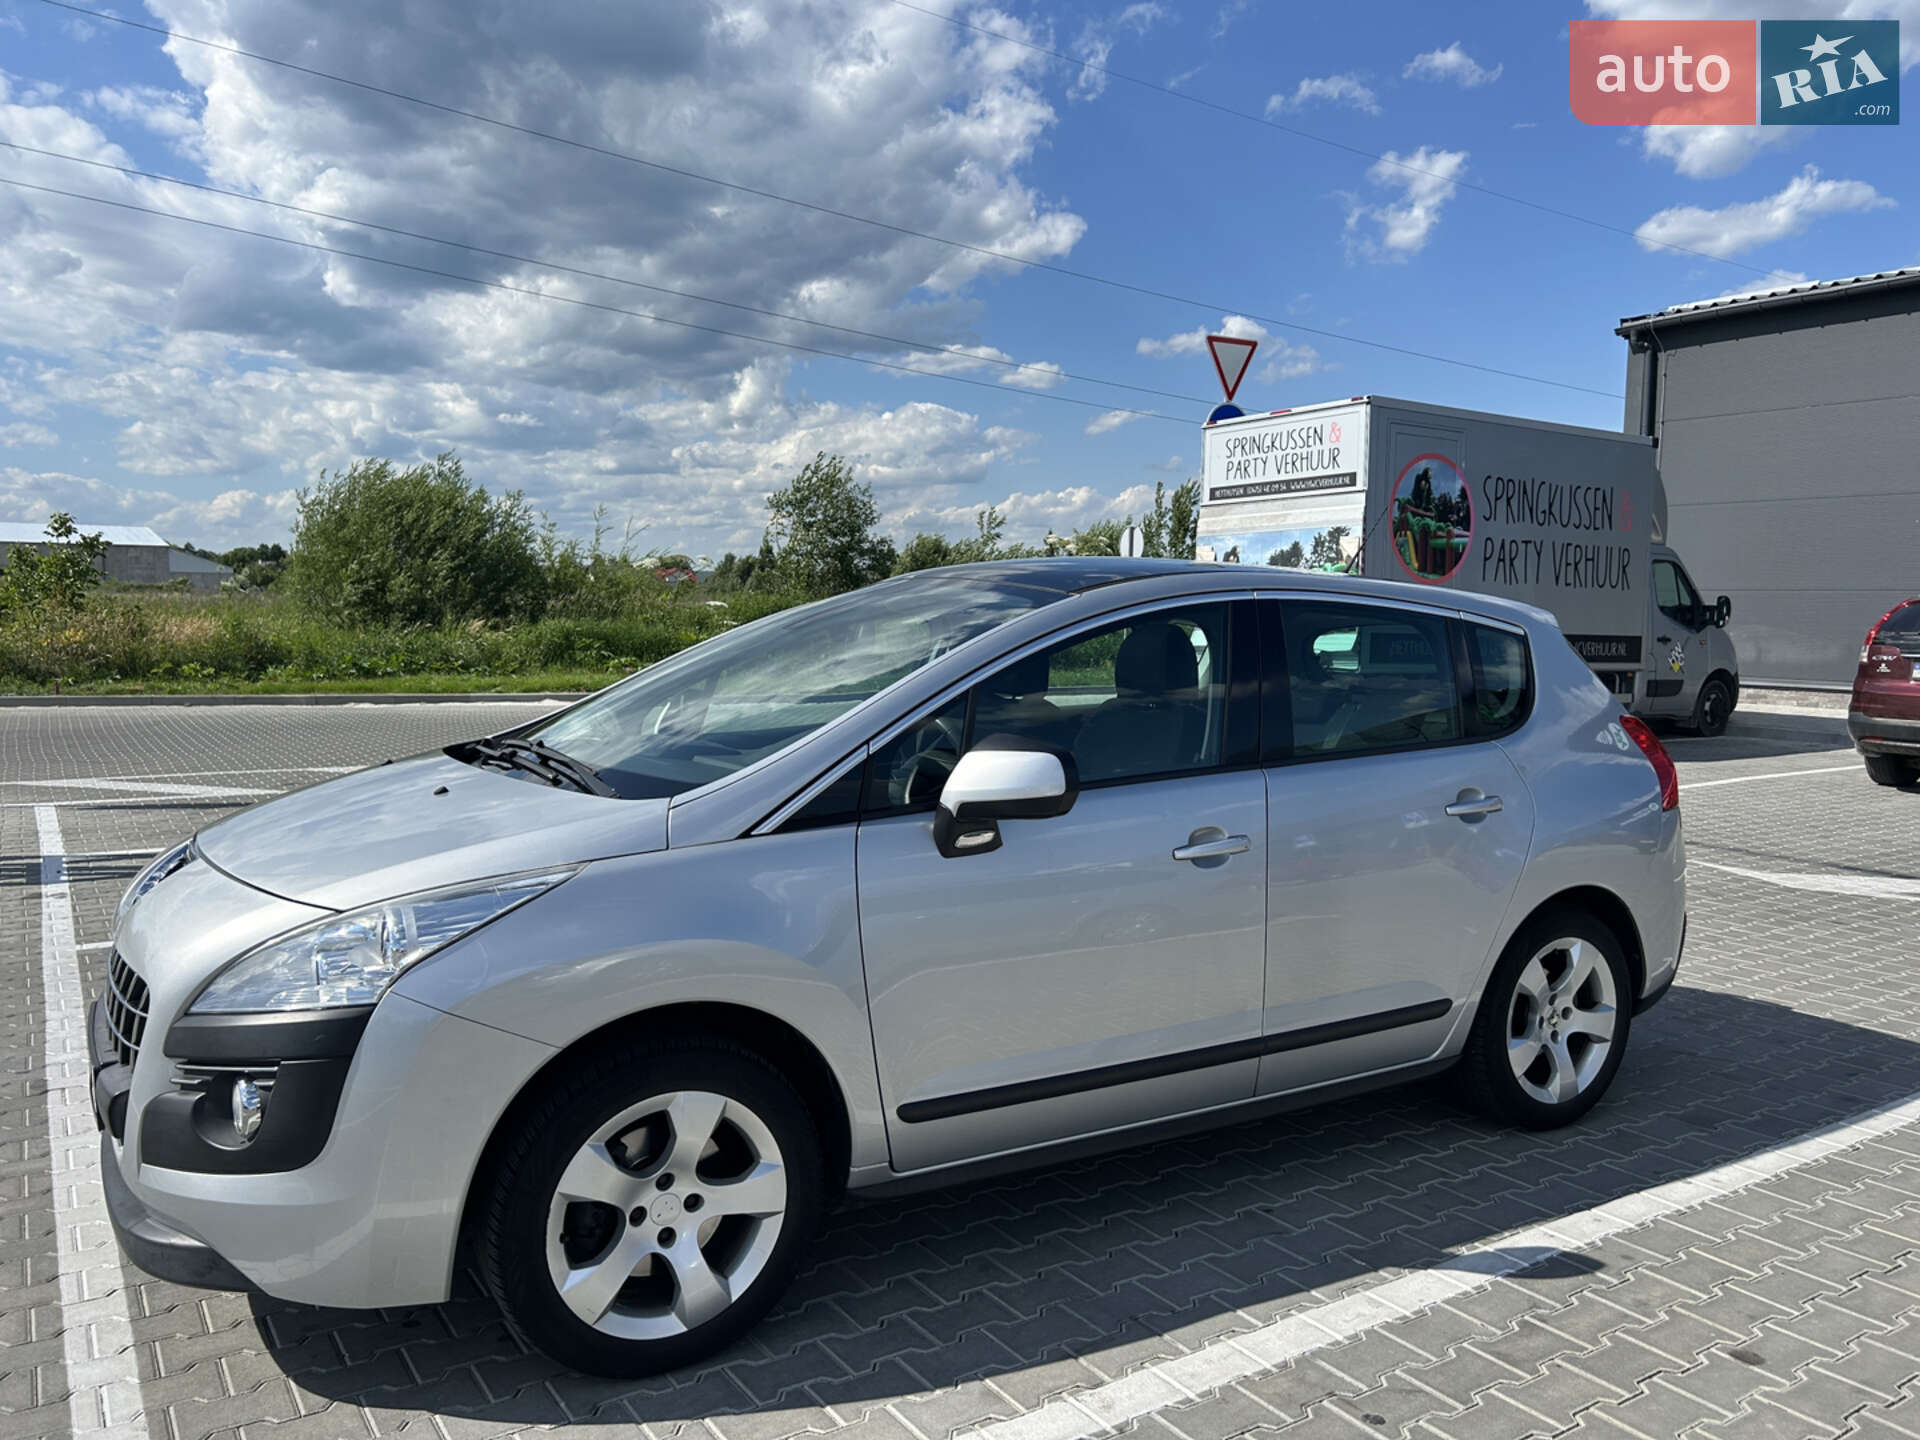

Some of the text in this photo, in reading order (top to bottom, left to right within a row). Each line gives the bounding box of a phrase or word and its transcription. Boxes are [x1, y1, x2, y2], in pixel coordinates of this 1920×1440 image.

[1225, 421, 1342, 459] SPRINGKUSSEN &
[1226, 447, 1341, 480] PARTY VERHUUR
[1483, 475, 1635, 532] SPRINGKUSSEN &
[1482, 537, 1631, 591] PARTY VERHUUR
